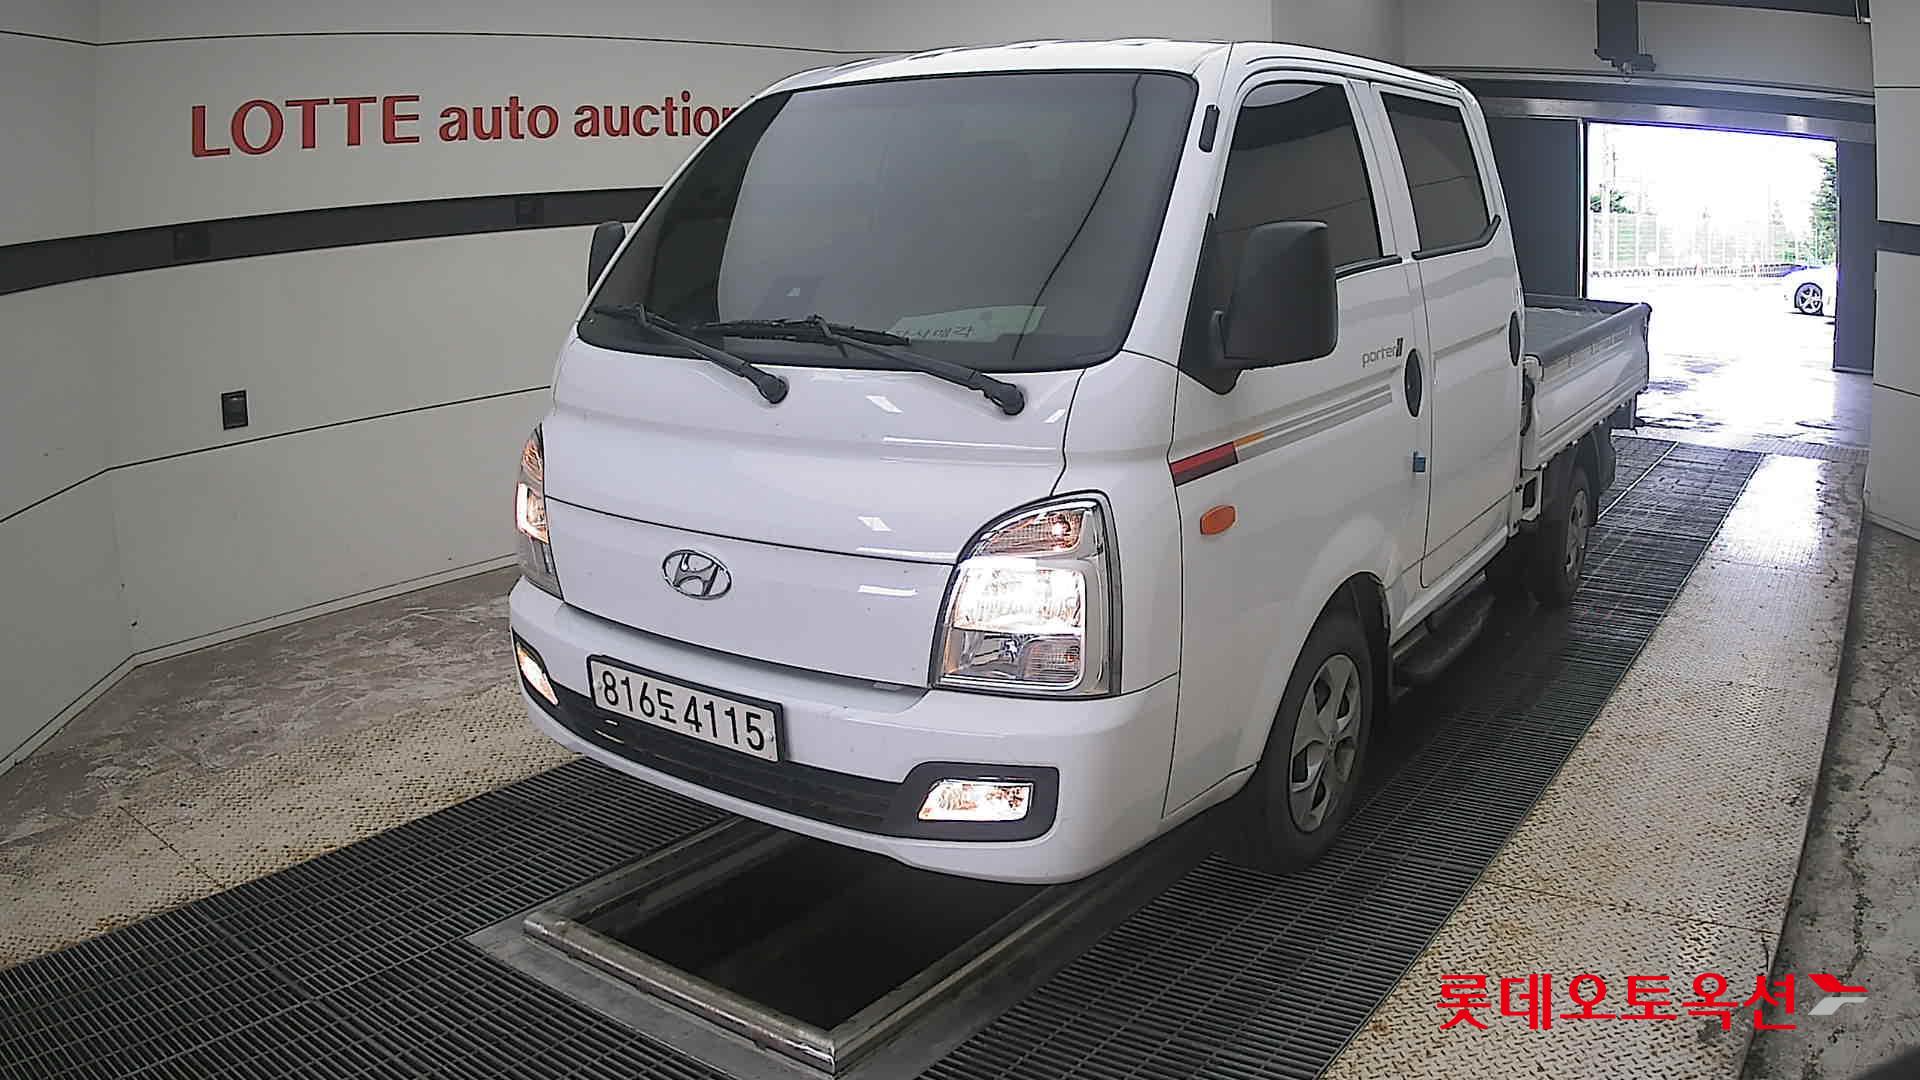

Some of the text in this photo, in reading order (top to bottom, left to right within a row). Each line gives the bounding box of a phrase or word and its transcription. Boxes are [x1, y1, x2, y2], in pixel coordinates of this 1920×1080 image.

[191, 95, 420, 157] LOTTE
[439, 95, 559, 141] auto
[601, 670, 765, 752] 816도4115
